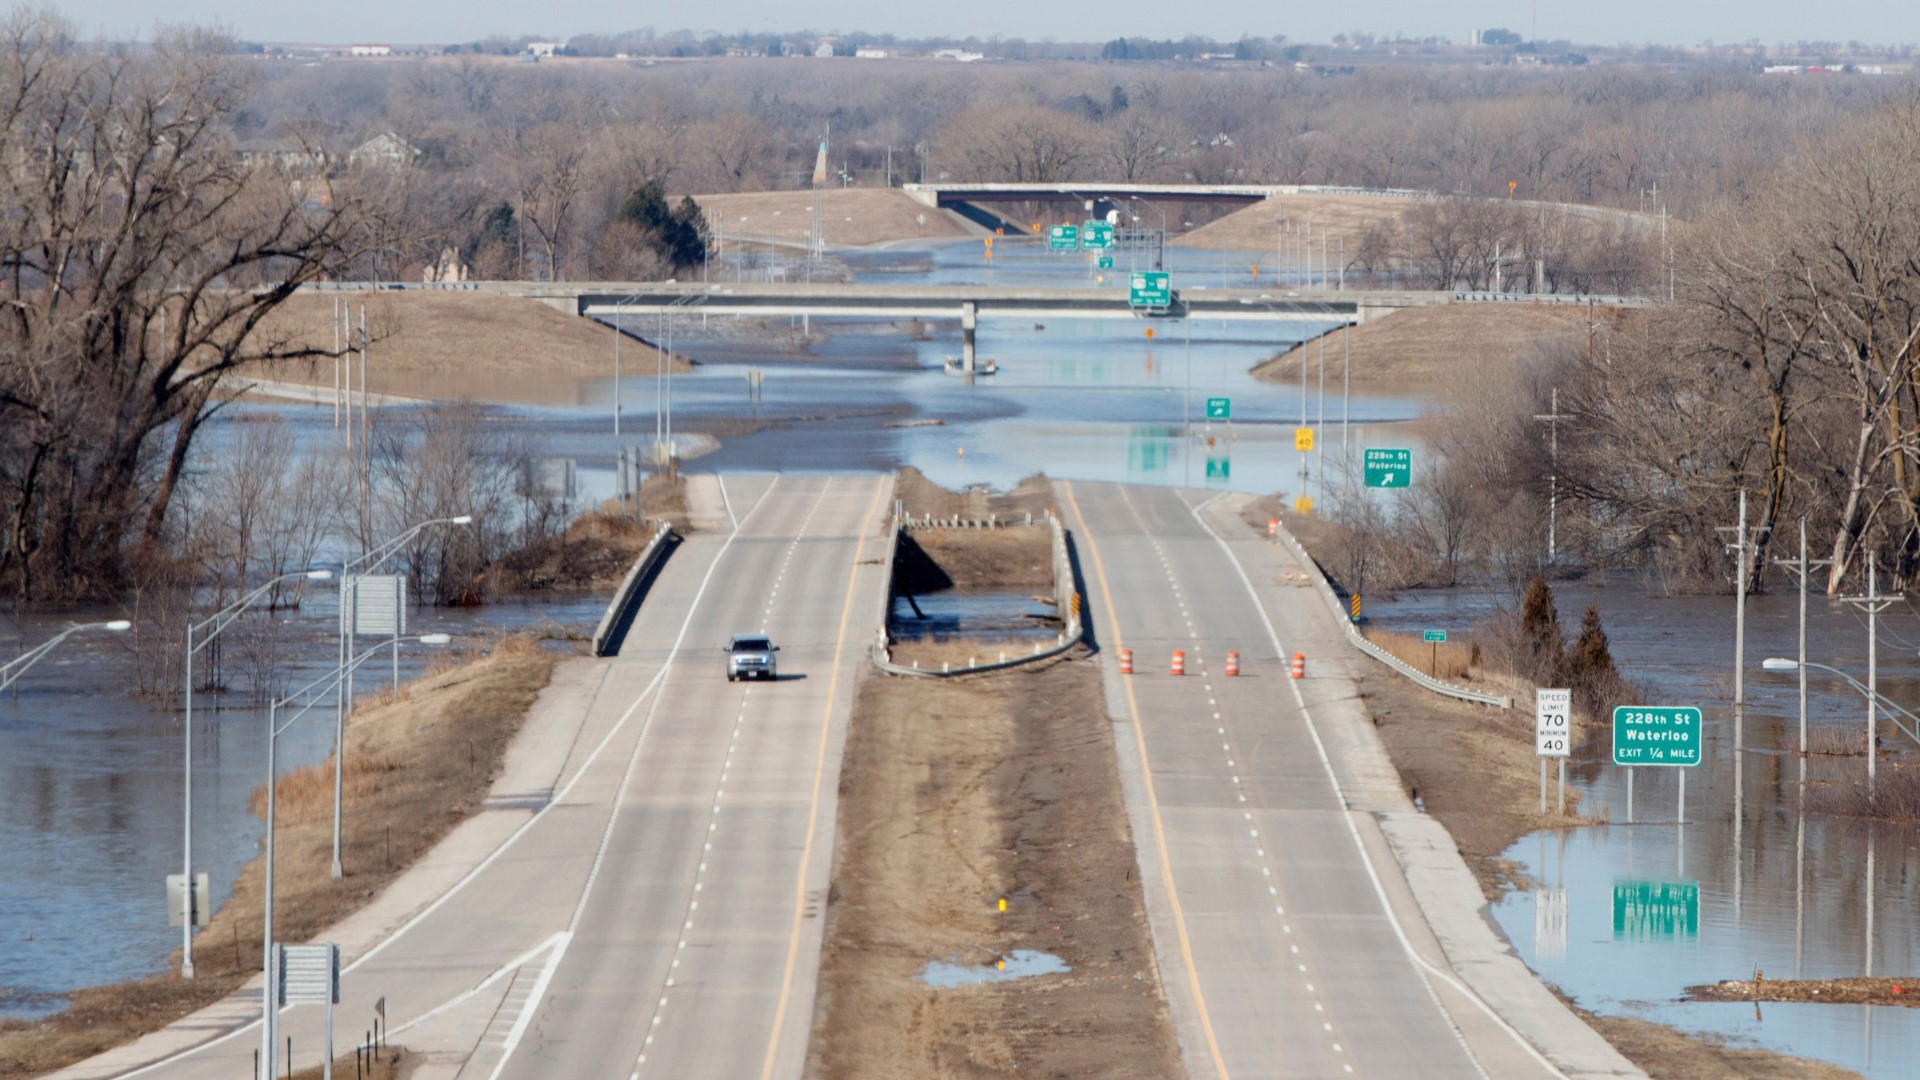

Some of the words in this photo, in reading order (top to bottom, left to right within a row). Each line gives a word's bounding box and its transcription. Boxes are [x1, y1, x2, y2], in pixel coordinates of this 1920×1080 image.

[1367, 451, 1394, 460] 228th
[1397, 451, 1408, 460] St
[1367, 461, 1407, 470] Waterloo
[1543, 714, 1564, 726] 70
[1625, 712, 1667, 725] 228th
[1674, 713, 1691, 725] St
[1626, 729, 1689, 741] Waterloo
[1543, 740, 1563, 751] 40
[1619, 748, 1642, 758] EXIT
[1670, 749, 1695, 758] MILE
